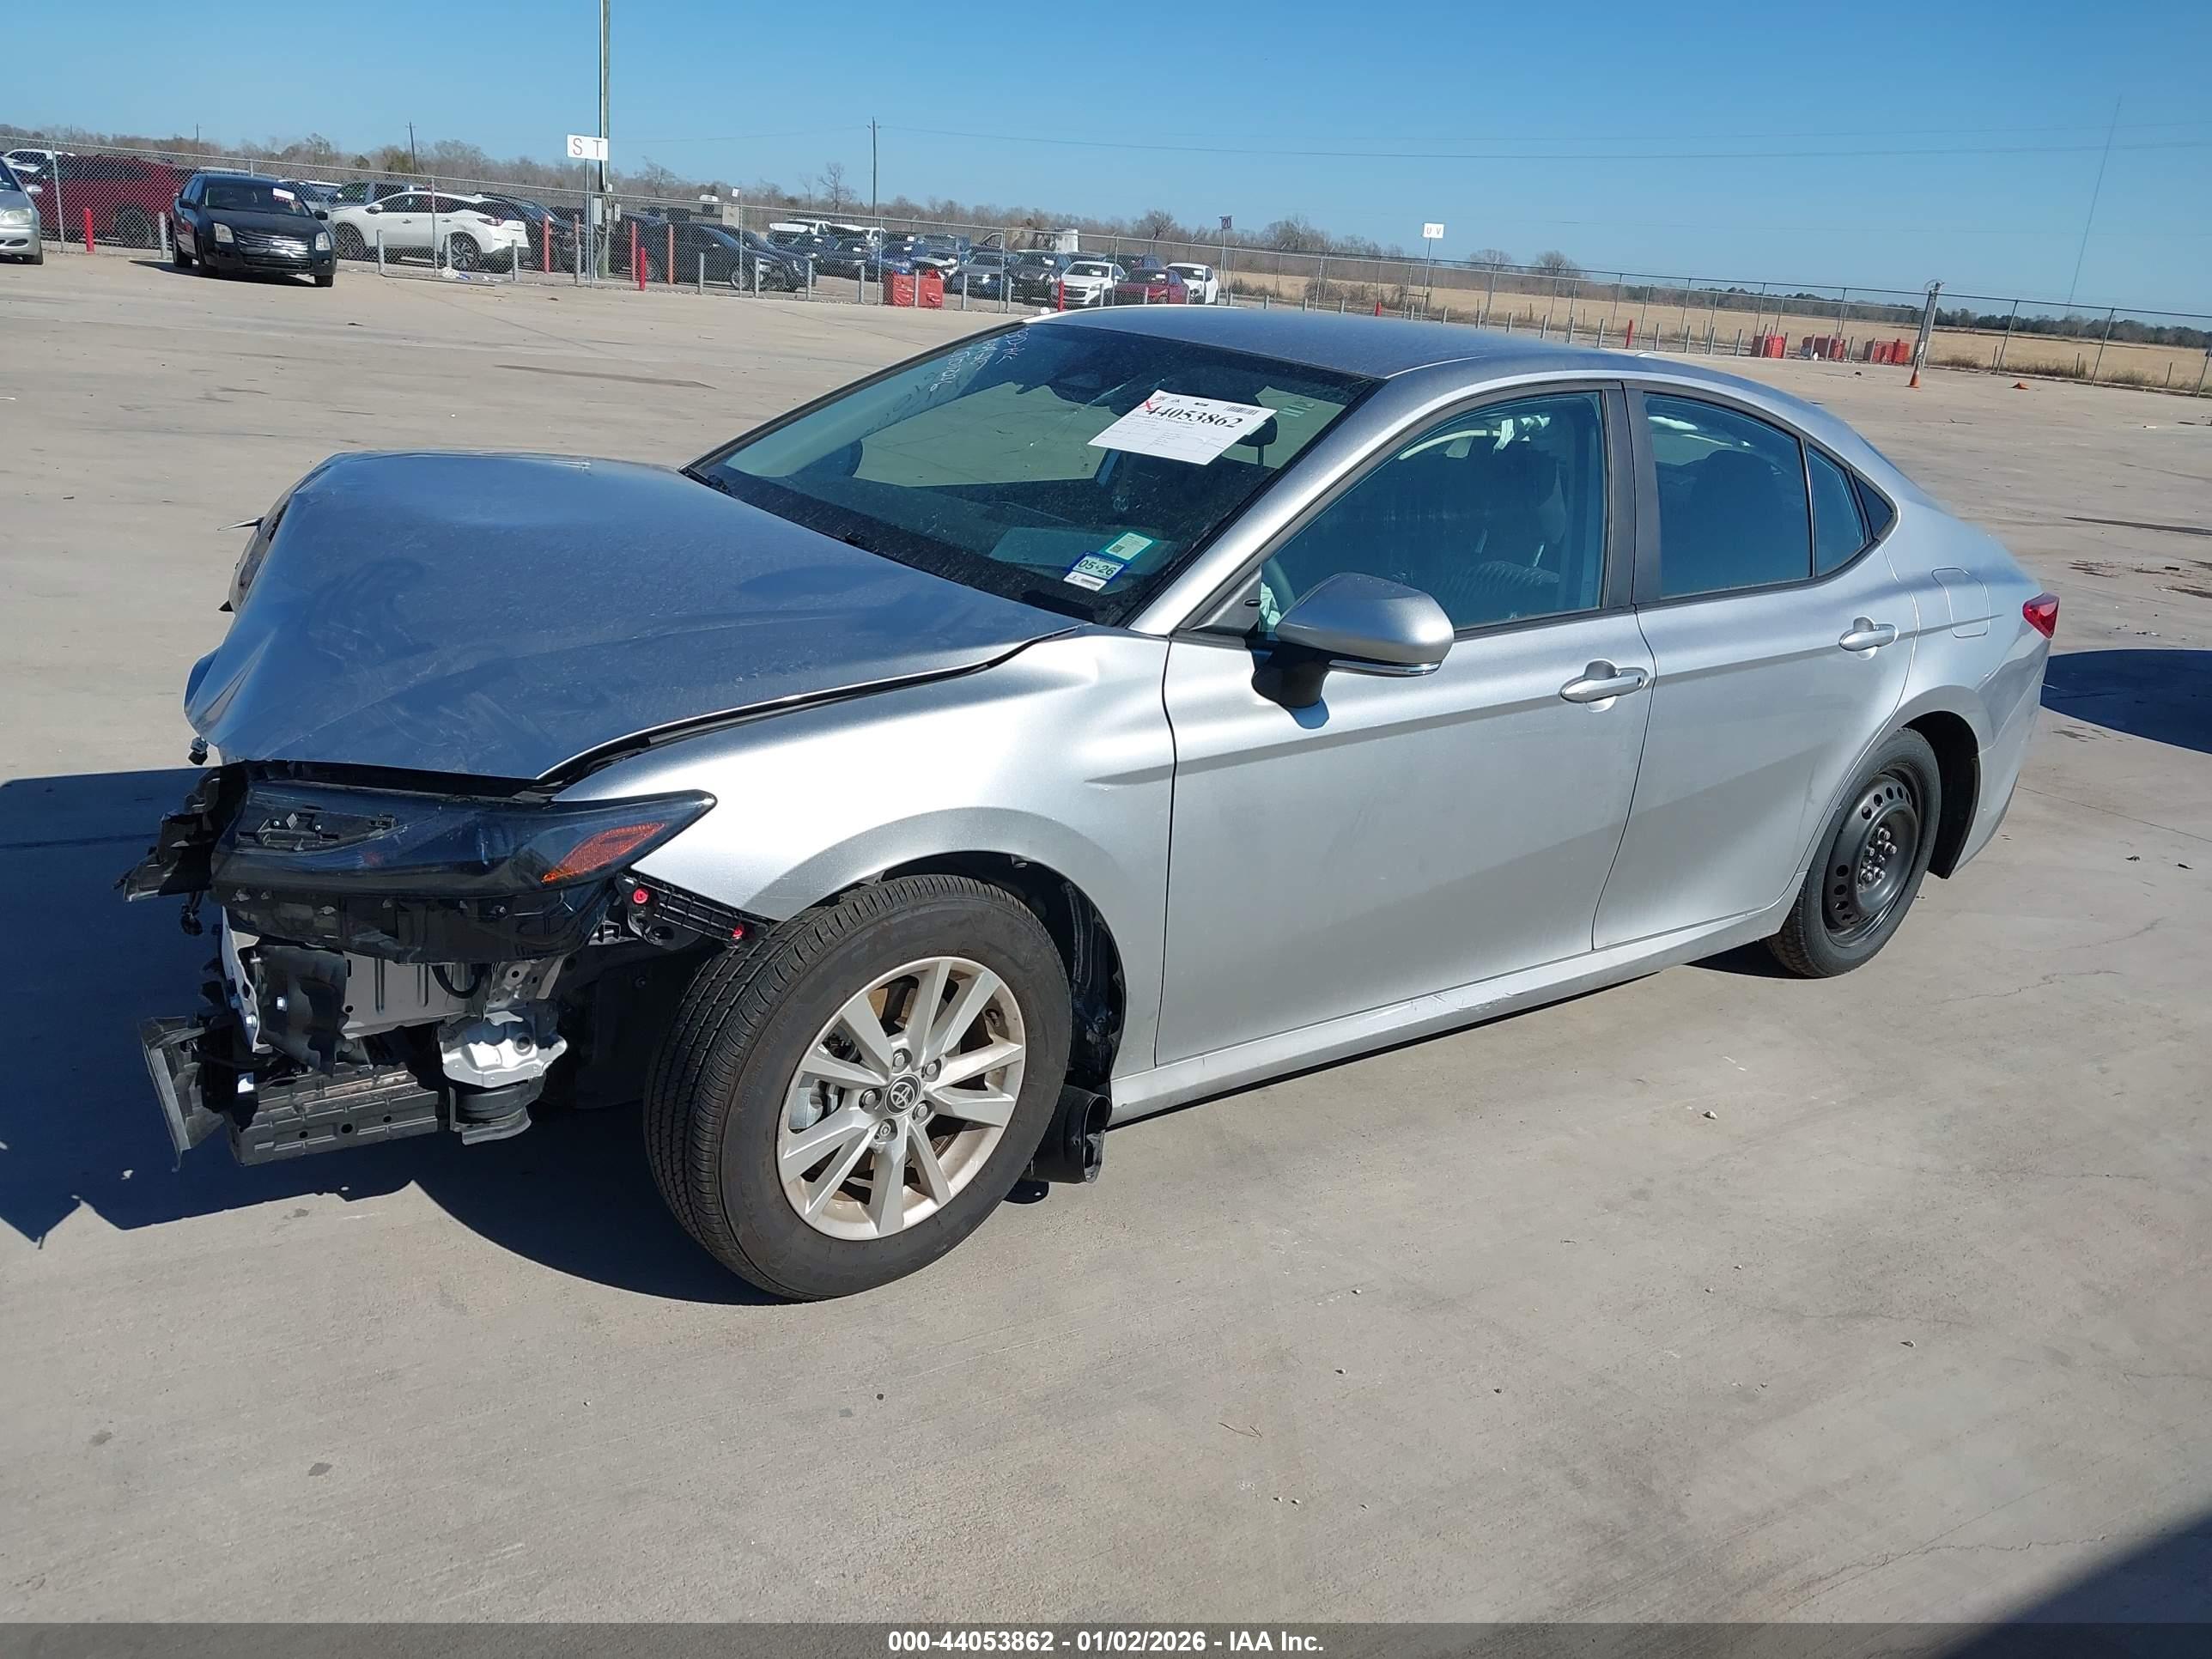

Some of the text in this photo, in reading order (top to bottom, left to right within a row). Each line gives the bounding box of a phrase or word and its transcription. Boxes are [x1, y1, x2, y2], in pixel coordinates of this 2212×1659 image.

[573, 137, 603, 157] S T
[1222, 217, 1231, 229] 20
[1436, 227, 1442, 235] V
[1146, 405, 1243, 428] 44053862
